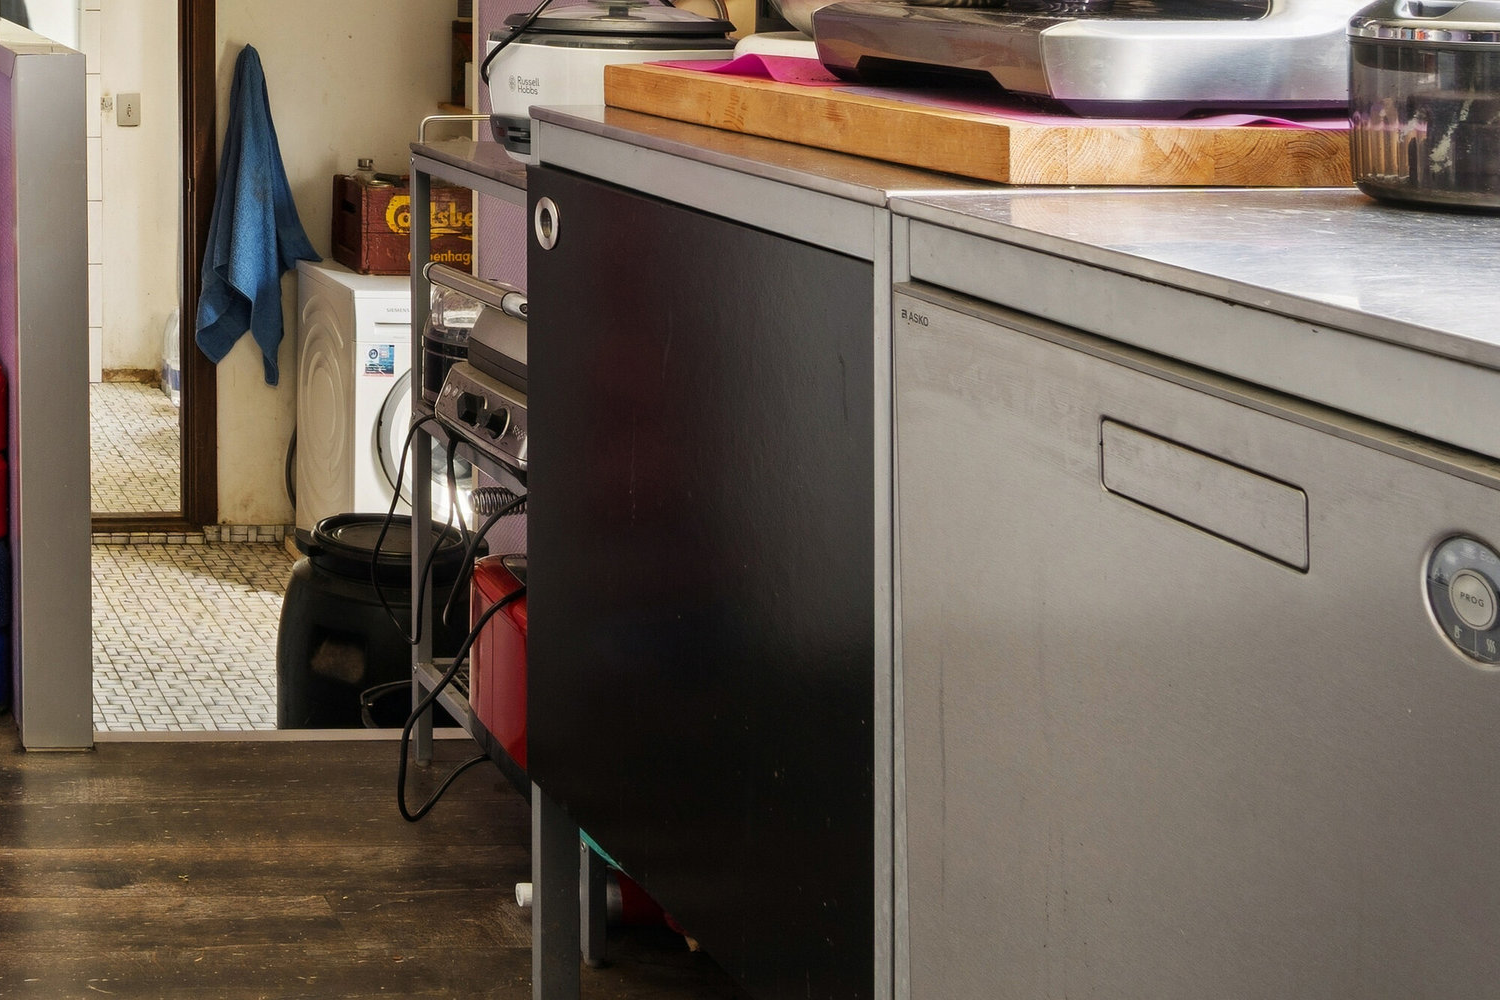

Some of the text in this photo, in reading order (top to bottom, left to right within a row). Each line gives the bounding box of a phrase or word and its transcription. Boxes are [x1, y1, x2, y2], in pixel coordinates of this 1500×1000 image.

[517, 75, 540, 87] Russell
[517, 84, 539, 95] Hobbs
[908, 311, 929, 327] ASKO
[1460, 591, 1485, 608] PROG
